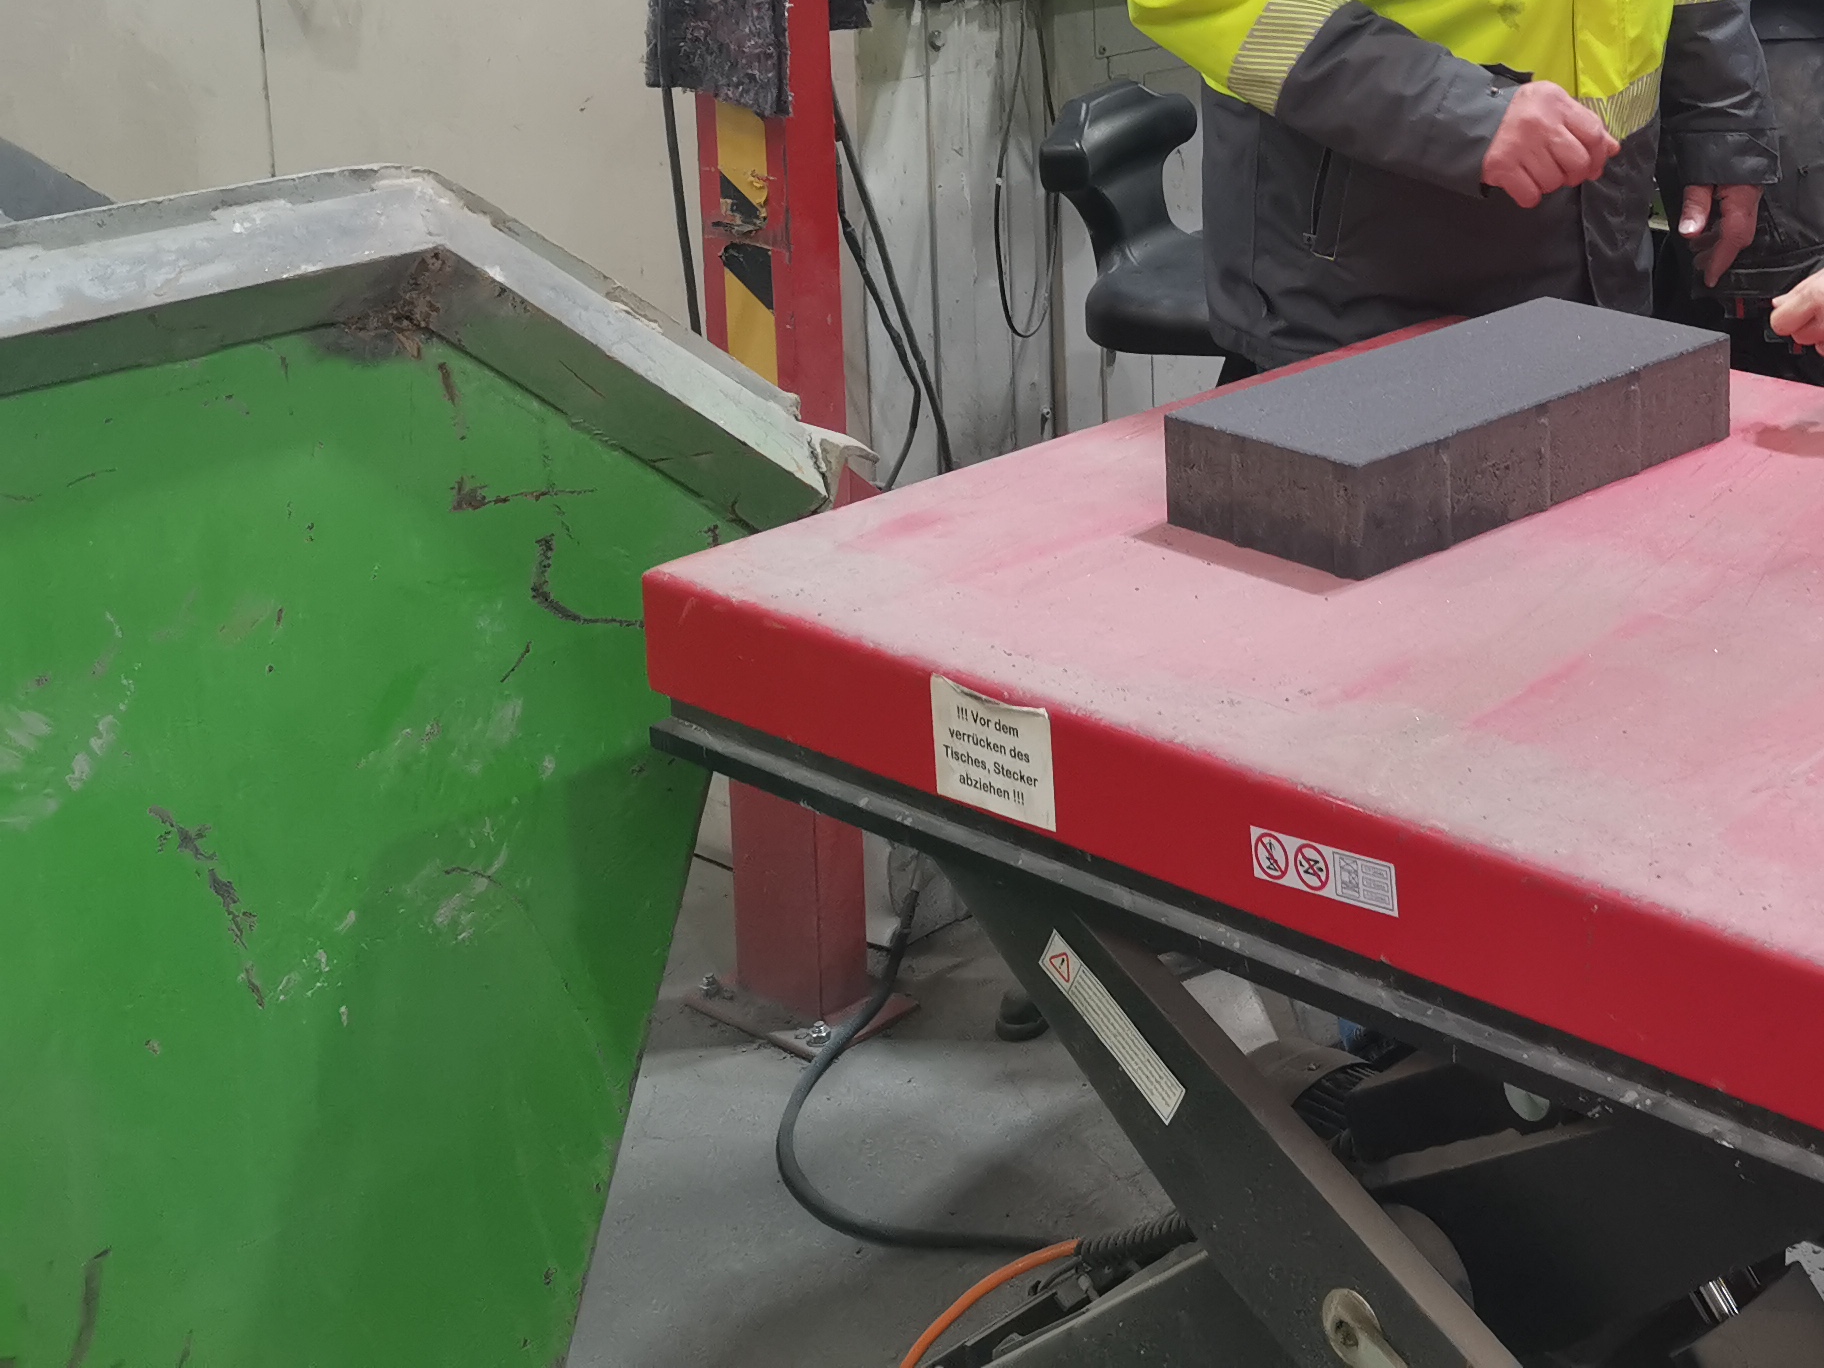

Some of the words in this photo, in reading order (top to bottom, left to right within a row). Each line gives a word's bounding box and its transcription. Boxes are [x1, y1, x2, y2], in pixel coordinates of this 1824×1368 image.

[971, 710, 992, 728] Vor
[994, 719, 1019, 738] dem
[948, 727, 1006, 755] verrücken
[1009, 747, 1030, 763] des
[943, 744, 991, 774] Tisches,
[993, 762, 1038, 787] Stecker
[959, 772, 1010, 800] abziehen
